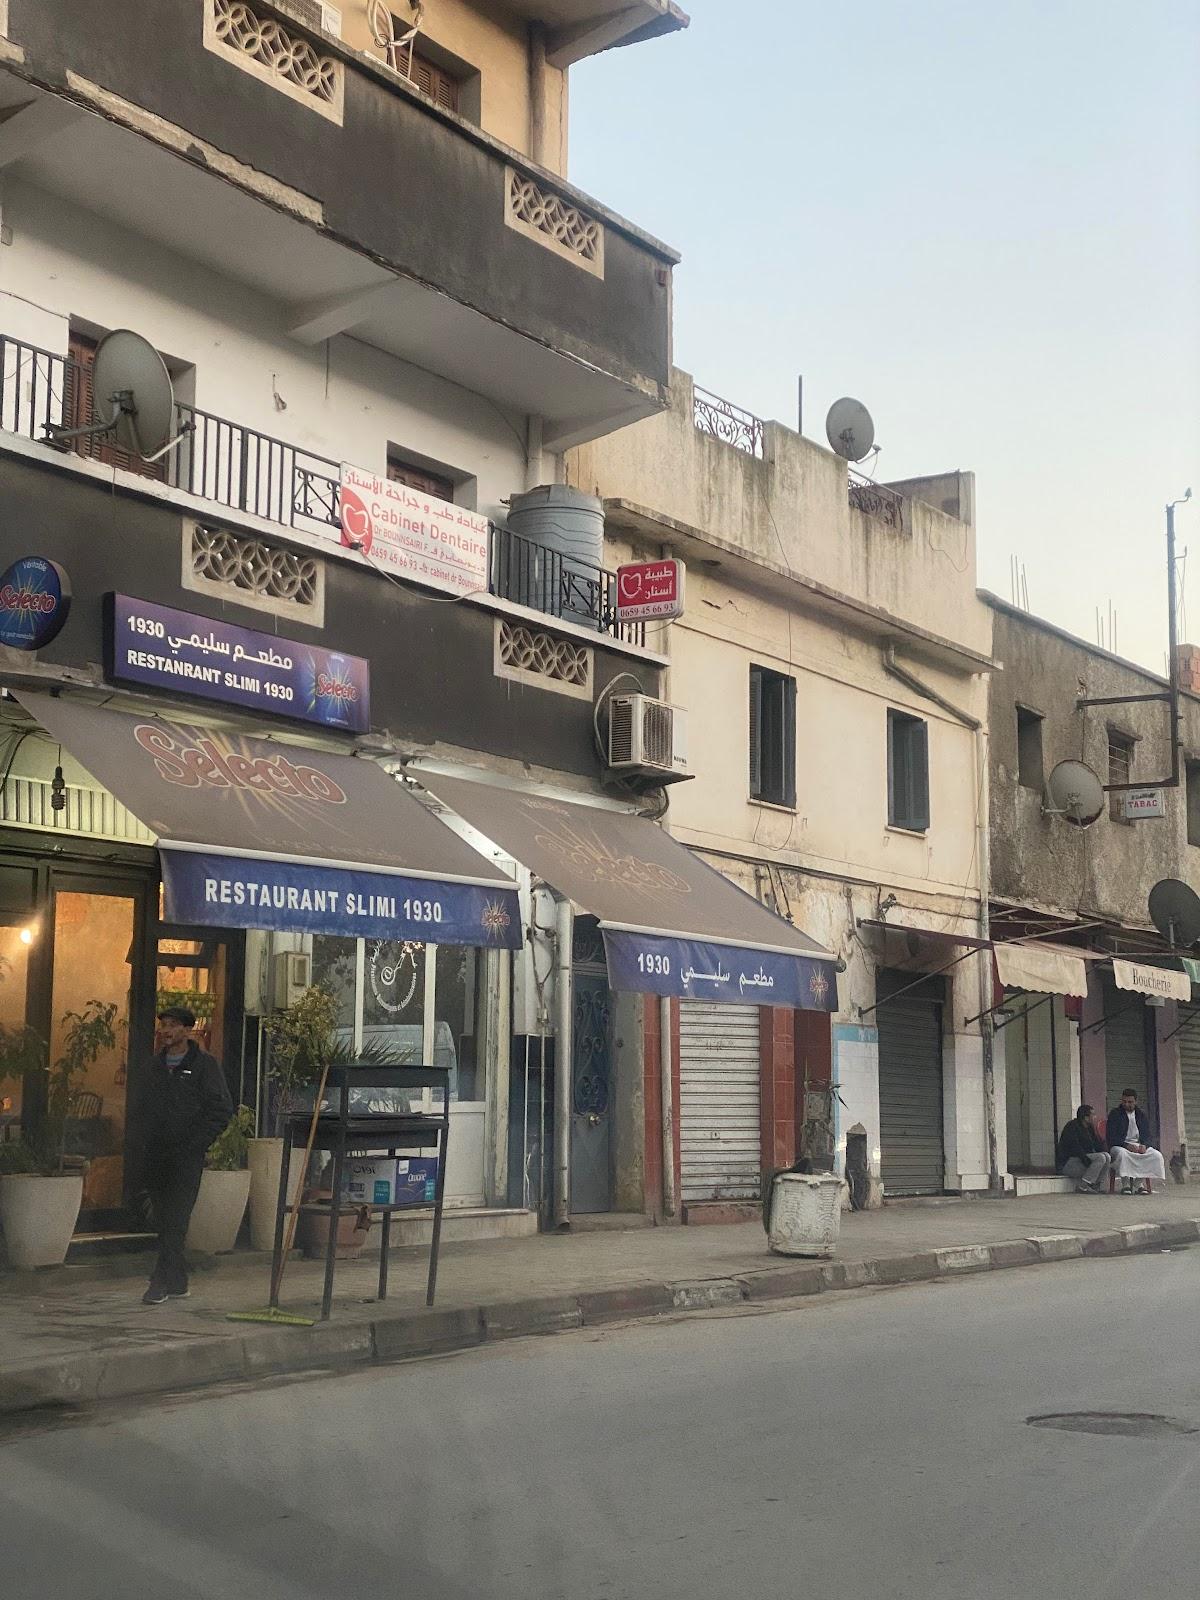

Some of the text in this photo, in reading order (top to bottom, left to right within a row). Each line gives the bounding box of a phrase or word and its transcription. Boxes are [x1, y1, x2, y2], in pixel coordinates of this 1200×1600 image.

[345, 470, 382, 496] الأسنان
[386, 484, 420, 510] جراحة
[433, 507, 454, 521] طب
[371, 503, 486, 558] Cabinet Dentaire
[389, 553, 398, 563] 45
[399, 556, 407, 567] 66
[408, 559, 418, 571] 93
[645, 566, 673, 581] طبيبة
[645, 580, 673, 599] أسنان
[620, 602, 674, 617] 0659 45 66 93
[127, 615, 293, 670] مطعم سليمي 1930
[127, 650, 294, 701] RESTANRANT SLIMI 1930
[317, 674, 361, 703] Selecto
[134, 724, 348, 803] Selecto
[1128, 799, 1158, 809] TABAC
[205, 878, 442, 923] RESTAURANT SLIMI 1930
[637, 952, 774, 995] مطعم سليمي 1930
[1132, 968, 1172, 993] Boucherie
